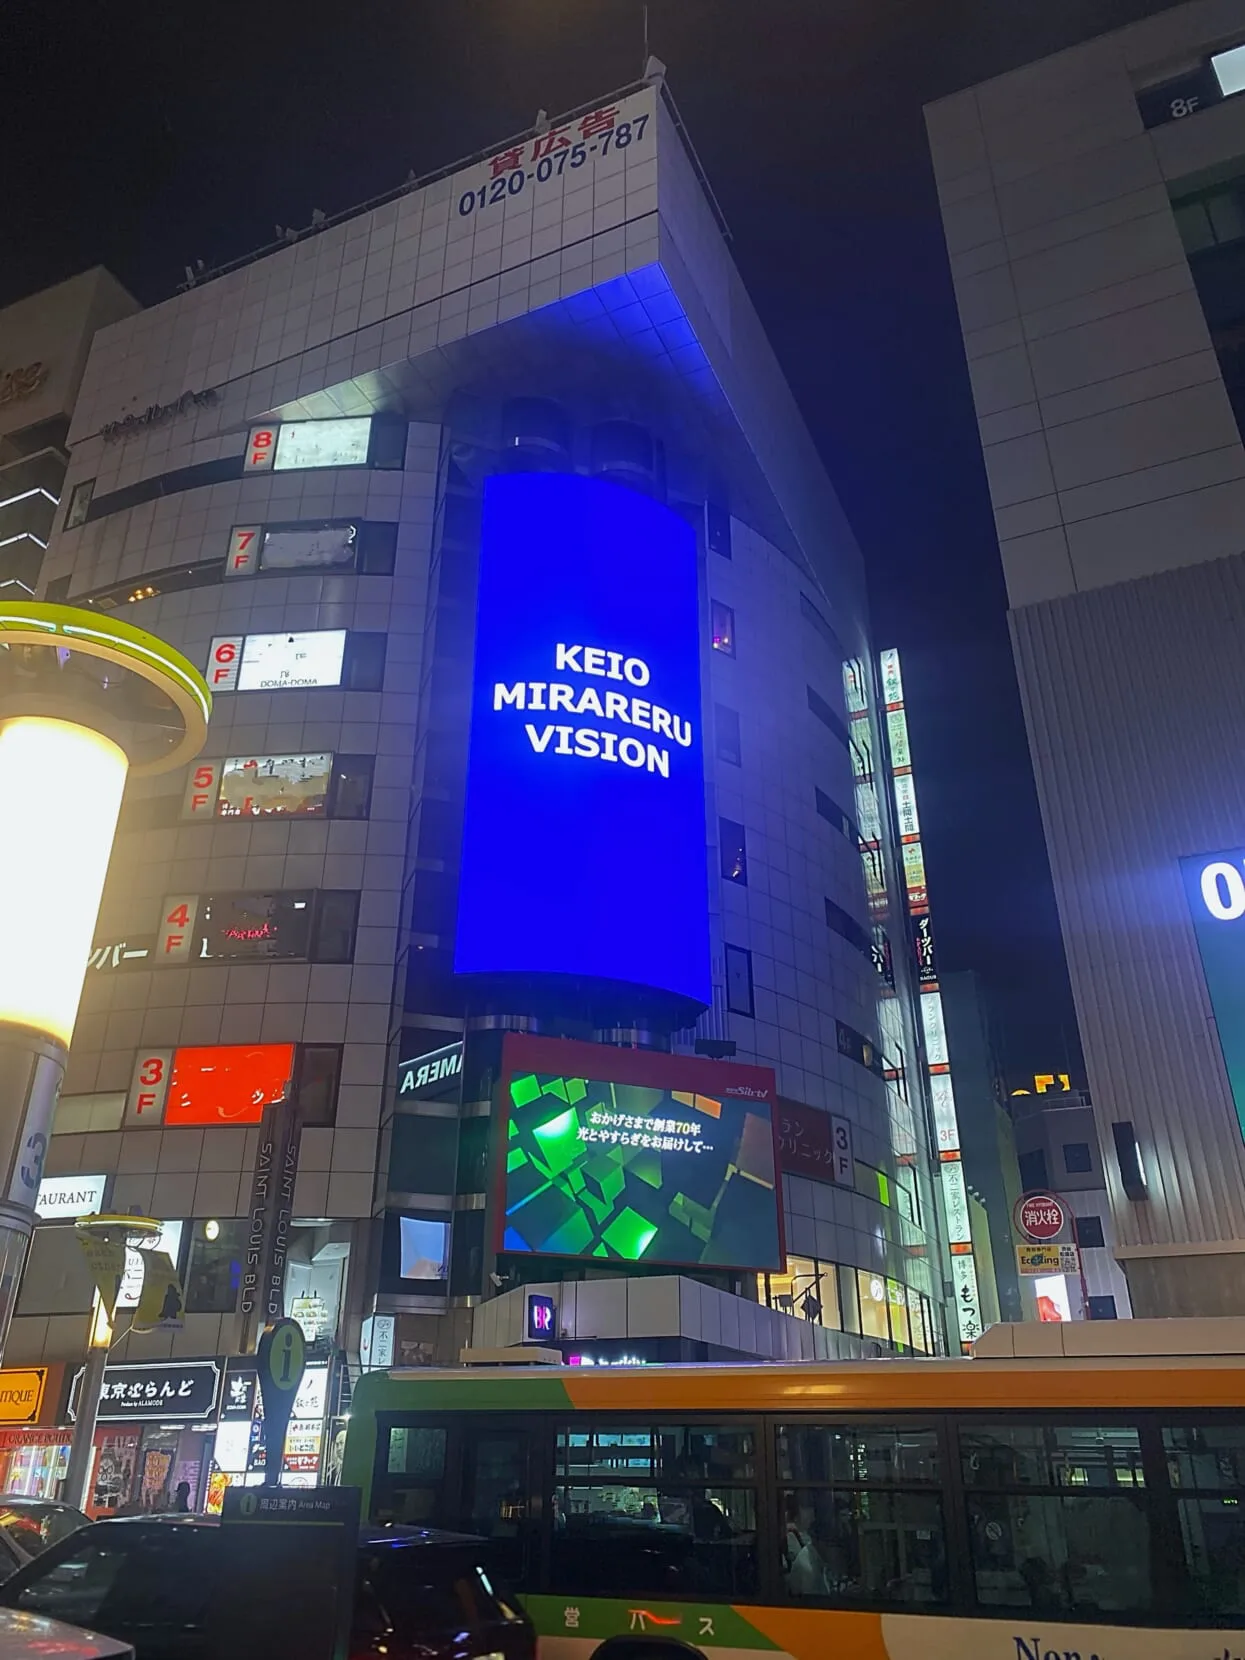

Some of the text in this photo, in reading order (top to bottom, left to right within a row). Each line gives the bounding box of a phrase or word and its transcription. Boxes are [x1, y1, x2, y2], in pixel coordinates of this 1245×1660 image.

[1170, 97, 1199, 117] 8F
[458, 114, 649, 216] 0120-075-787
[489, 106, 620, 180] 貸広告
[556, 643, 650, 687] KEIO
[493, 682, 691, 747] MIRARERU
[524, 724, 669, 778] VISION
[590, 1111, 701, 1136] おかげさまで創業70年
[241, 1143, 272, 1313] SAINT LOUIS BLD
[268, 1145, 296, 1314] SAINT LOUIS BLD
[1025, 1209, 1060, 1227] 消火栓
[0, 1390, 34, 1405] TIQUE
